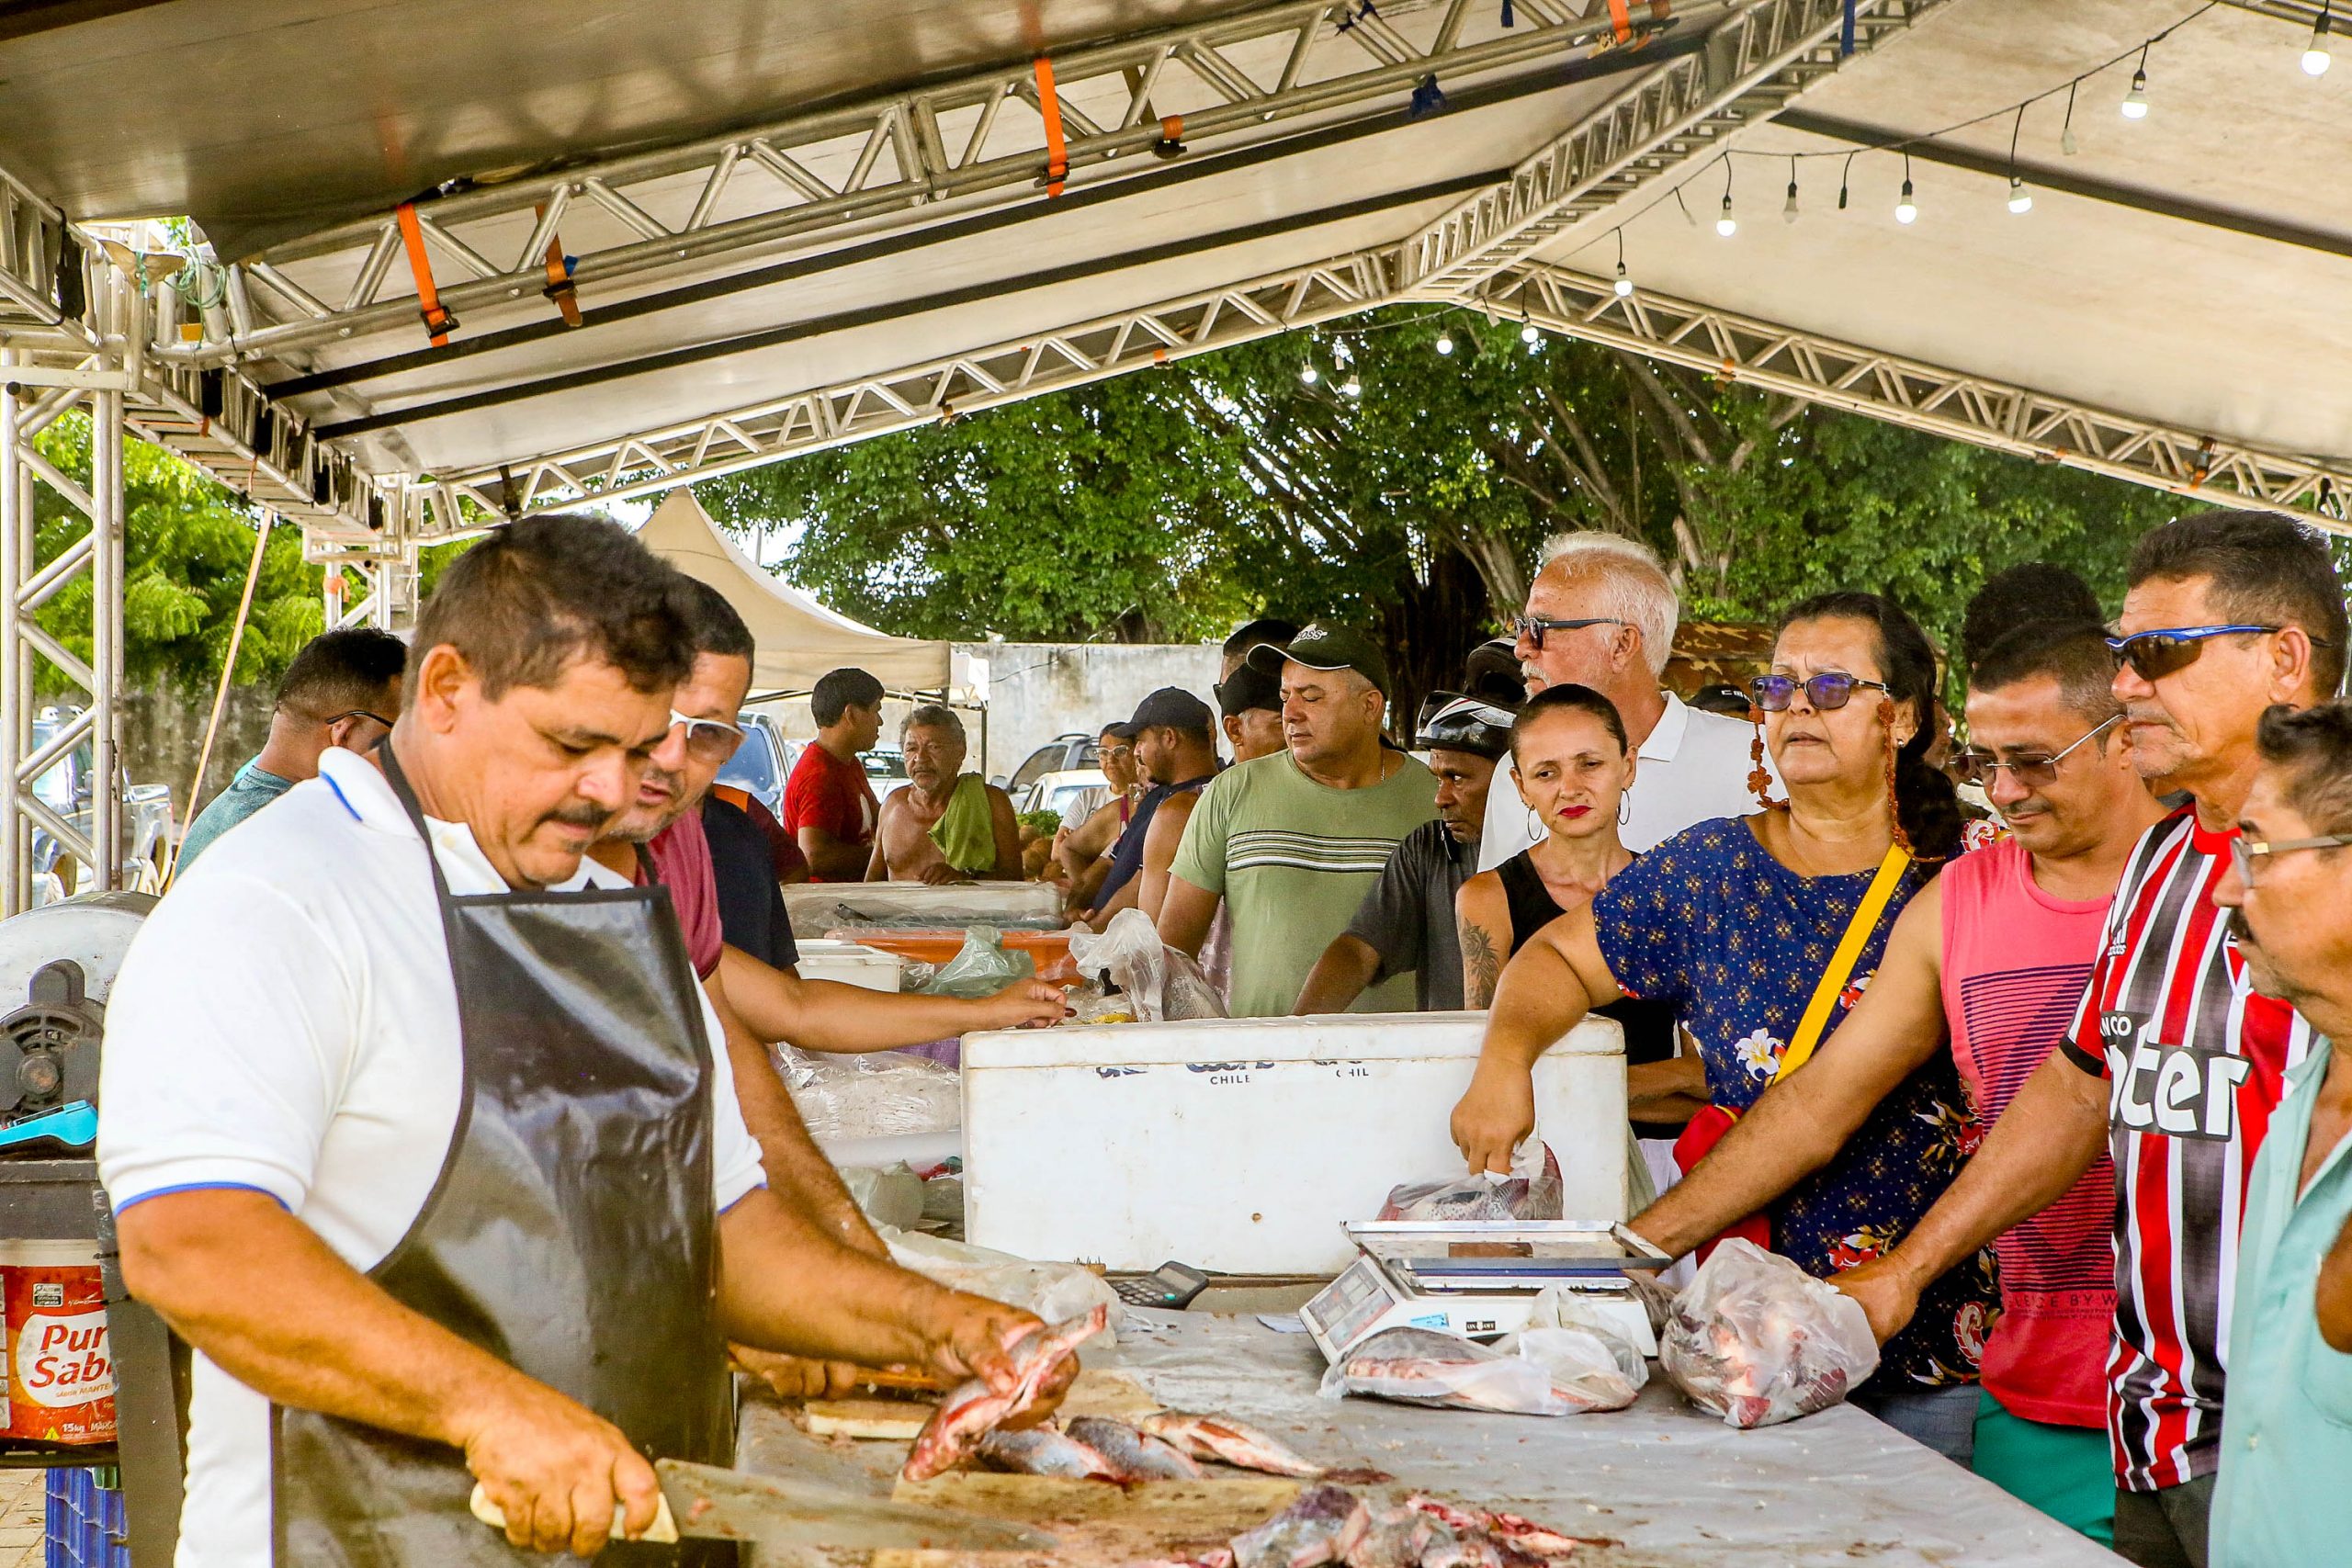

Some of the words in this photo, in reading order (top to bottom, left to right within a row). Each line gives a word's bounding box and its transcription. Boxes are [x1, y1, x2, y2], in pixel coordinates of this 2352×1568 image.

[1210, 1075, 1250, 1085] CHILE
[2070, 1293, 2094, 1306] BY
[40, 1325, 108, 1352] Pur
[79, 1382, 111, 1394] MANTE
